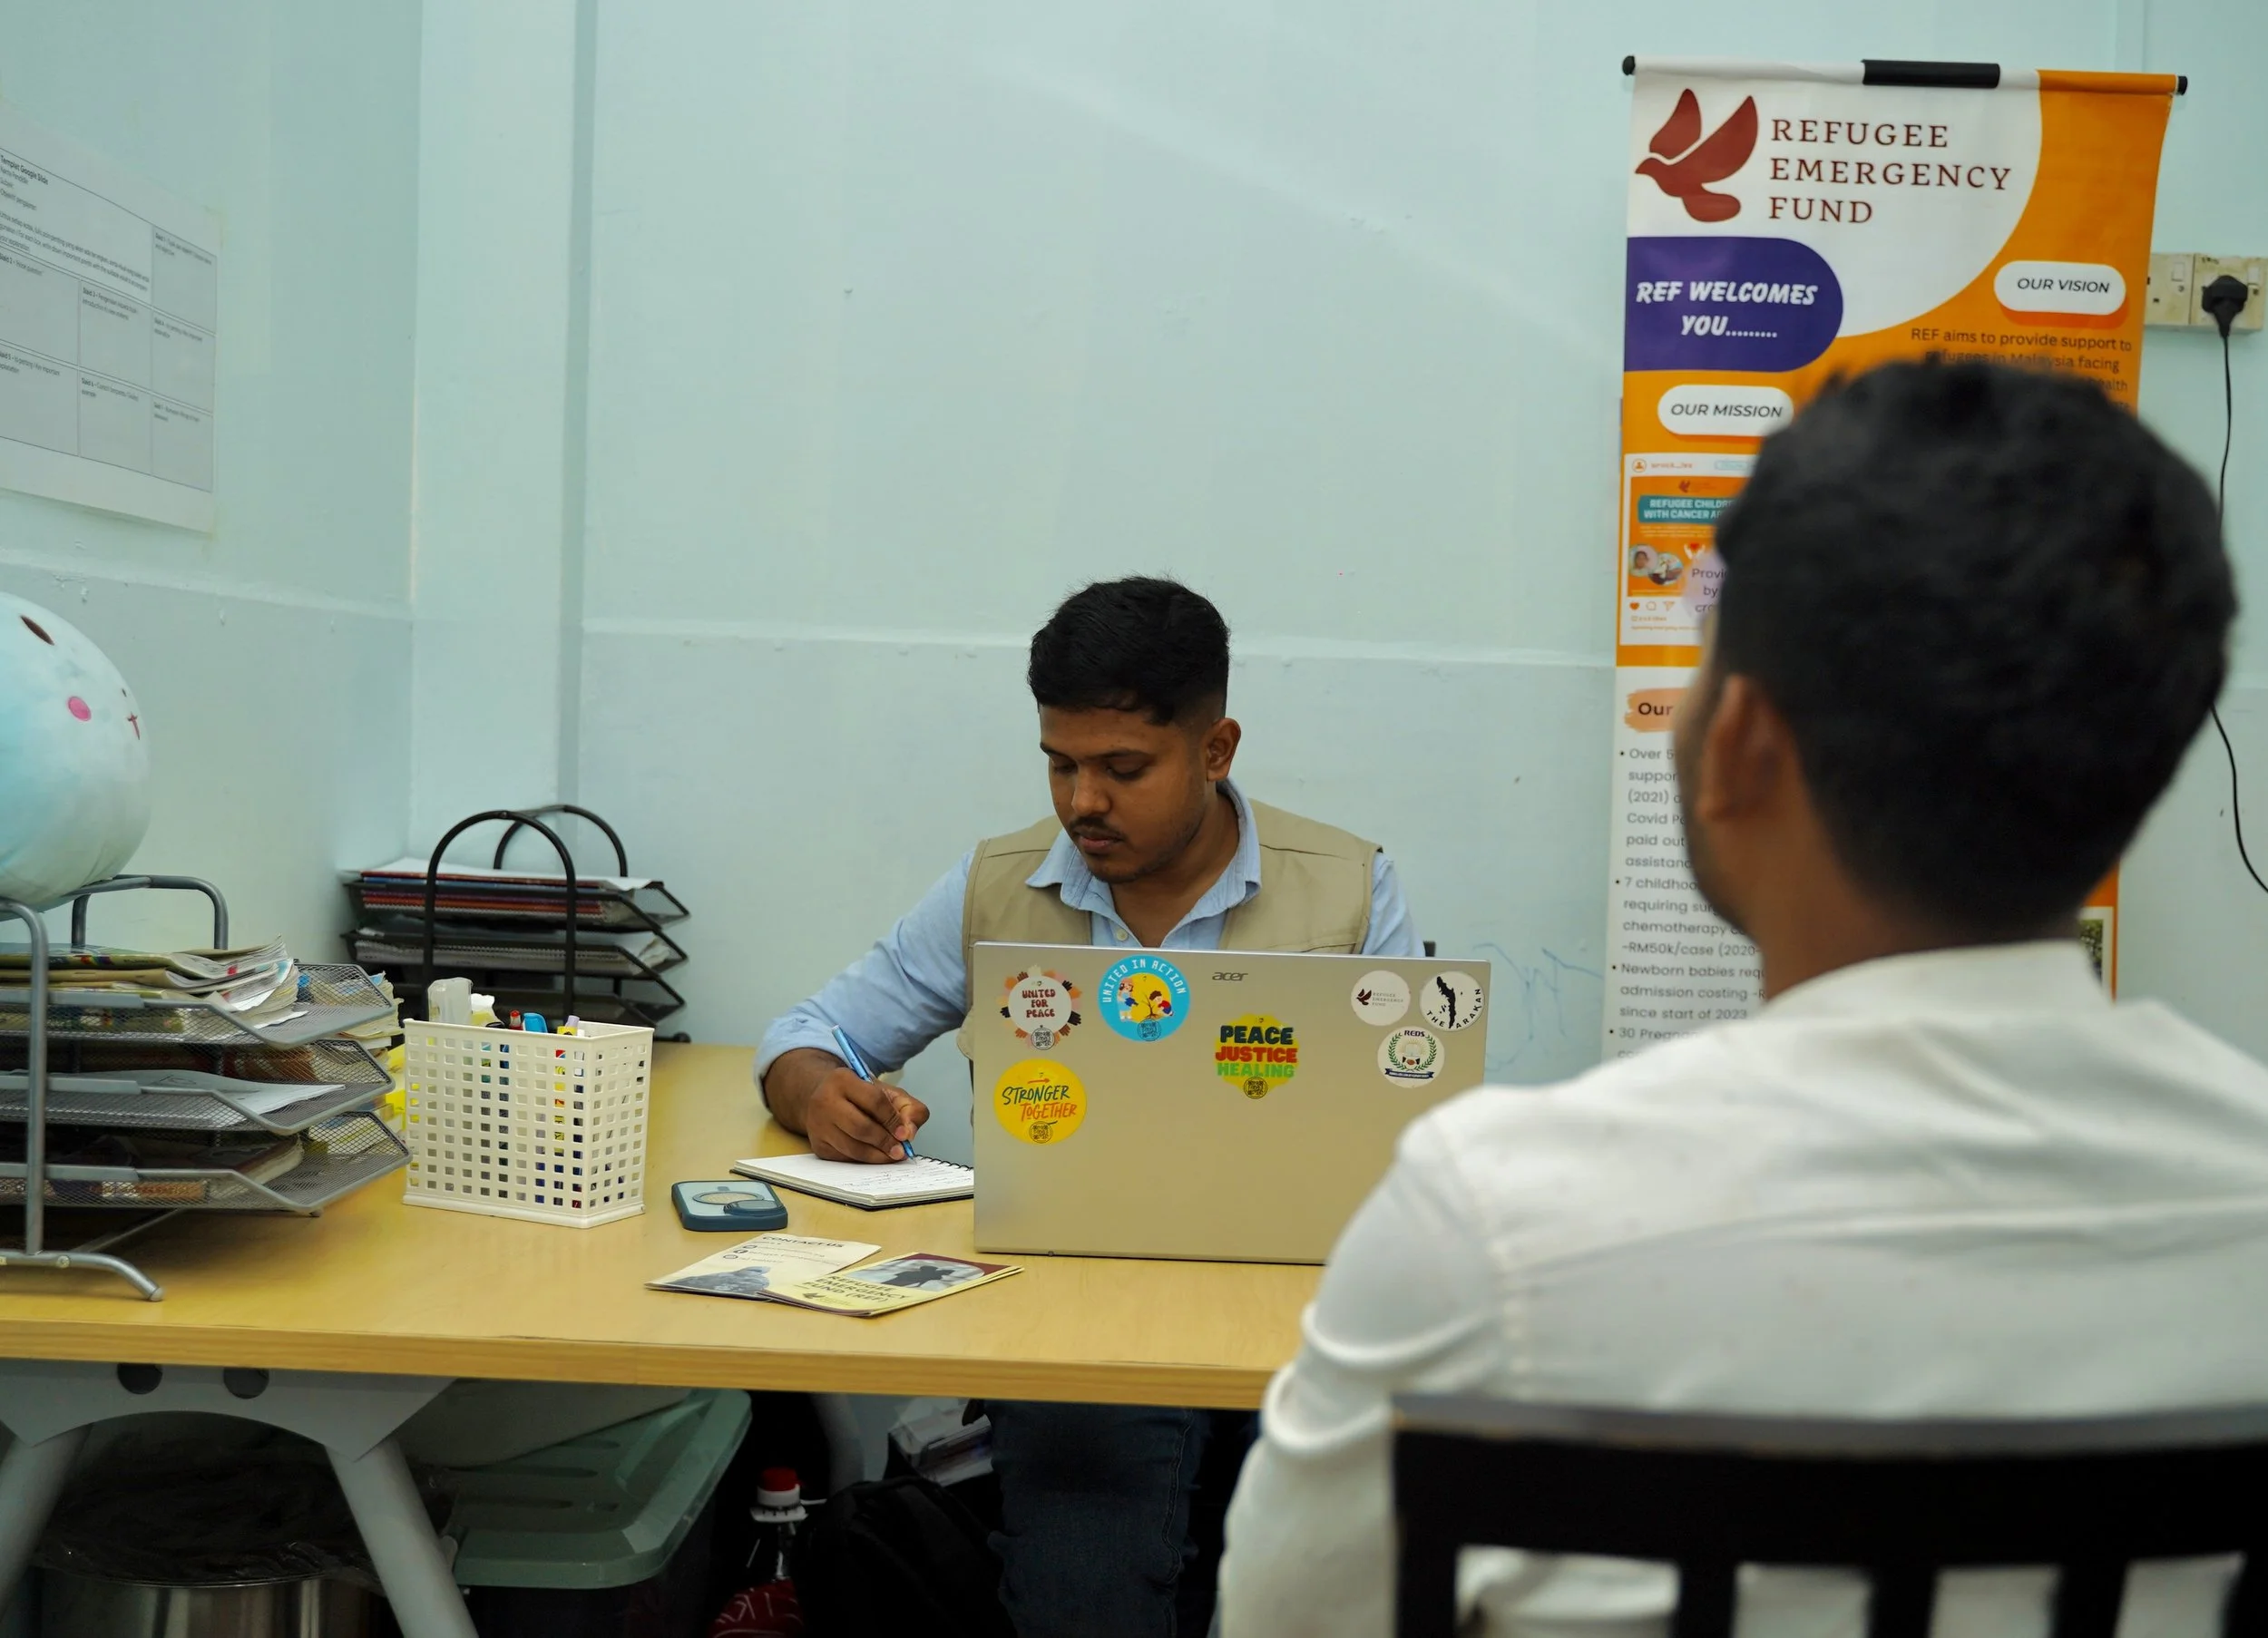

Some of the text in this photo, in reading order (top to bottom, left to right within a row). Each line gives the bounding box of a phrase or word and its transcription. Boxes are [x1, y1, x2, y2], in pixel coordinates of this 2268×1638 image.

[1771, 119, 1948, 148] REFUGEE
[1770, 157, 2011, 190] EMERGENCY
[1768, 196, 1872, 223] FUND
[2017, 278, 2110, 293] OUR VISION
[1636, 281, 1819, 306] REF WELCOMES
[1911, 327, 2132, 352] REF aims to provide support to
[2077, 354, 2119, 374] facing
[1671, 404, 1784, 418] OUR MISSION
[1649, 498, 1694, 509] REFUGEE
[1643, 509, 1669, 519] WITH
[1670, 509, 1709, 520] CANCER
[1692, 568, 1727, 579] Provi
[1703, 586, 1719, 599] by
[1637, 702, 1673, 716] Our
[1629, 747, 1675, 760] Over 5
[1628, 771, 1677, 785] suppor
[1628, 789, 1669, 805] (2021)
[1627, 811, 1668, 824] Covid
[1626, 834, 1685, 848] paid out
[1624, 877, 1698, 890] 7 childhoo
[1623, 899, 1688, 914] requiring
[1622, 919, 1725, 938] chemotherapy
[1211, 971, 1248, 981] acer
[1621, 962, 1685, 977] Newborn
[1688, 964, 1735, 978] babies
[1101, 958, 1188, 1003] UNITED IN ACTION
[1022, 988, 1056, 999] UNITED
[1619, 984, 1694, 999] admission
[1697, 987, 1748, 1002] costing
[1031, 999, 1049, 1009] FOR
[1426, 988, 1483, 1029] THE ARAKAN
[1026, 1009, 1056, 1019] PEACE
[1618, 1005, 1748, 1020] since start of 2023
[1219, 1025, 1295, 1045] PEACE
[1403, 1029, 1426, 1038] REDS
[1618, 1026, 1636, 1039] 30
[1215, 1045, 1298, 1064] JUSTICE
[1217, 1061, 1295, 1078] HEALING
[1002, 1084, 1070, 1106] STRONGER
[1019, 1101, 1078, 1123] TOGETHER
[762, 1235, 827, 1246] CONTACT
[816, 1278, 911, 1300] EMERGENCY
[828, 1275, 894, 1292] REFUGEE
[802, 1281, 846, 1294] FUND
[846, 1292, 888, 1302] (REF)
